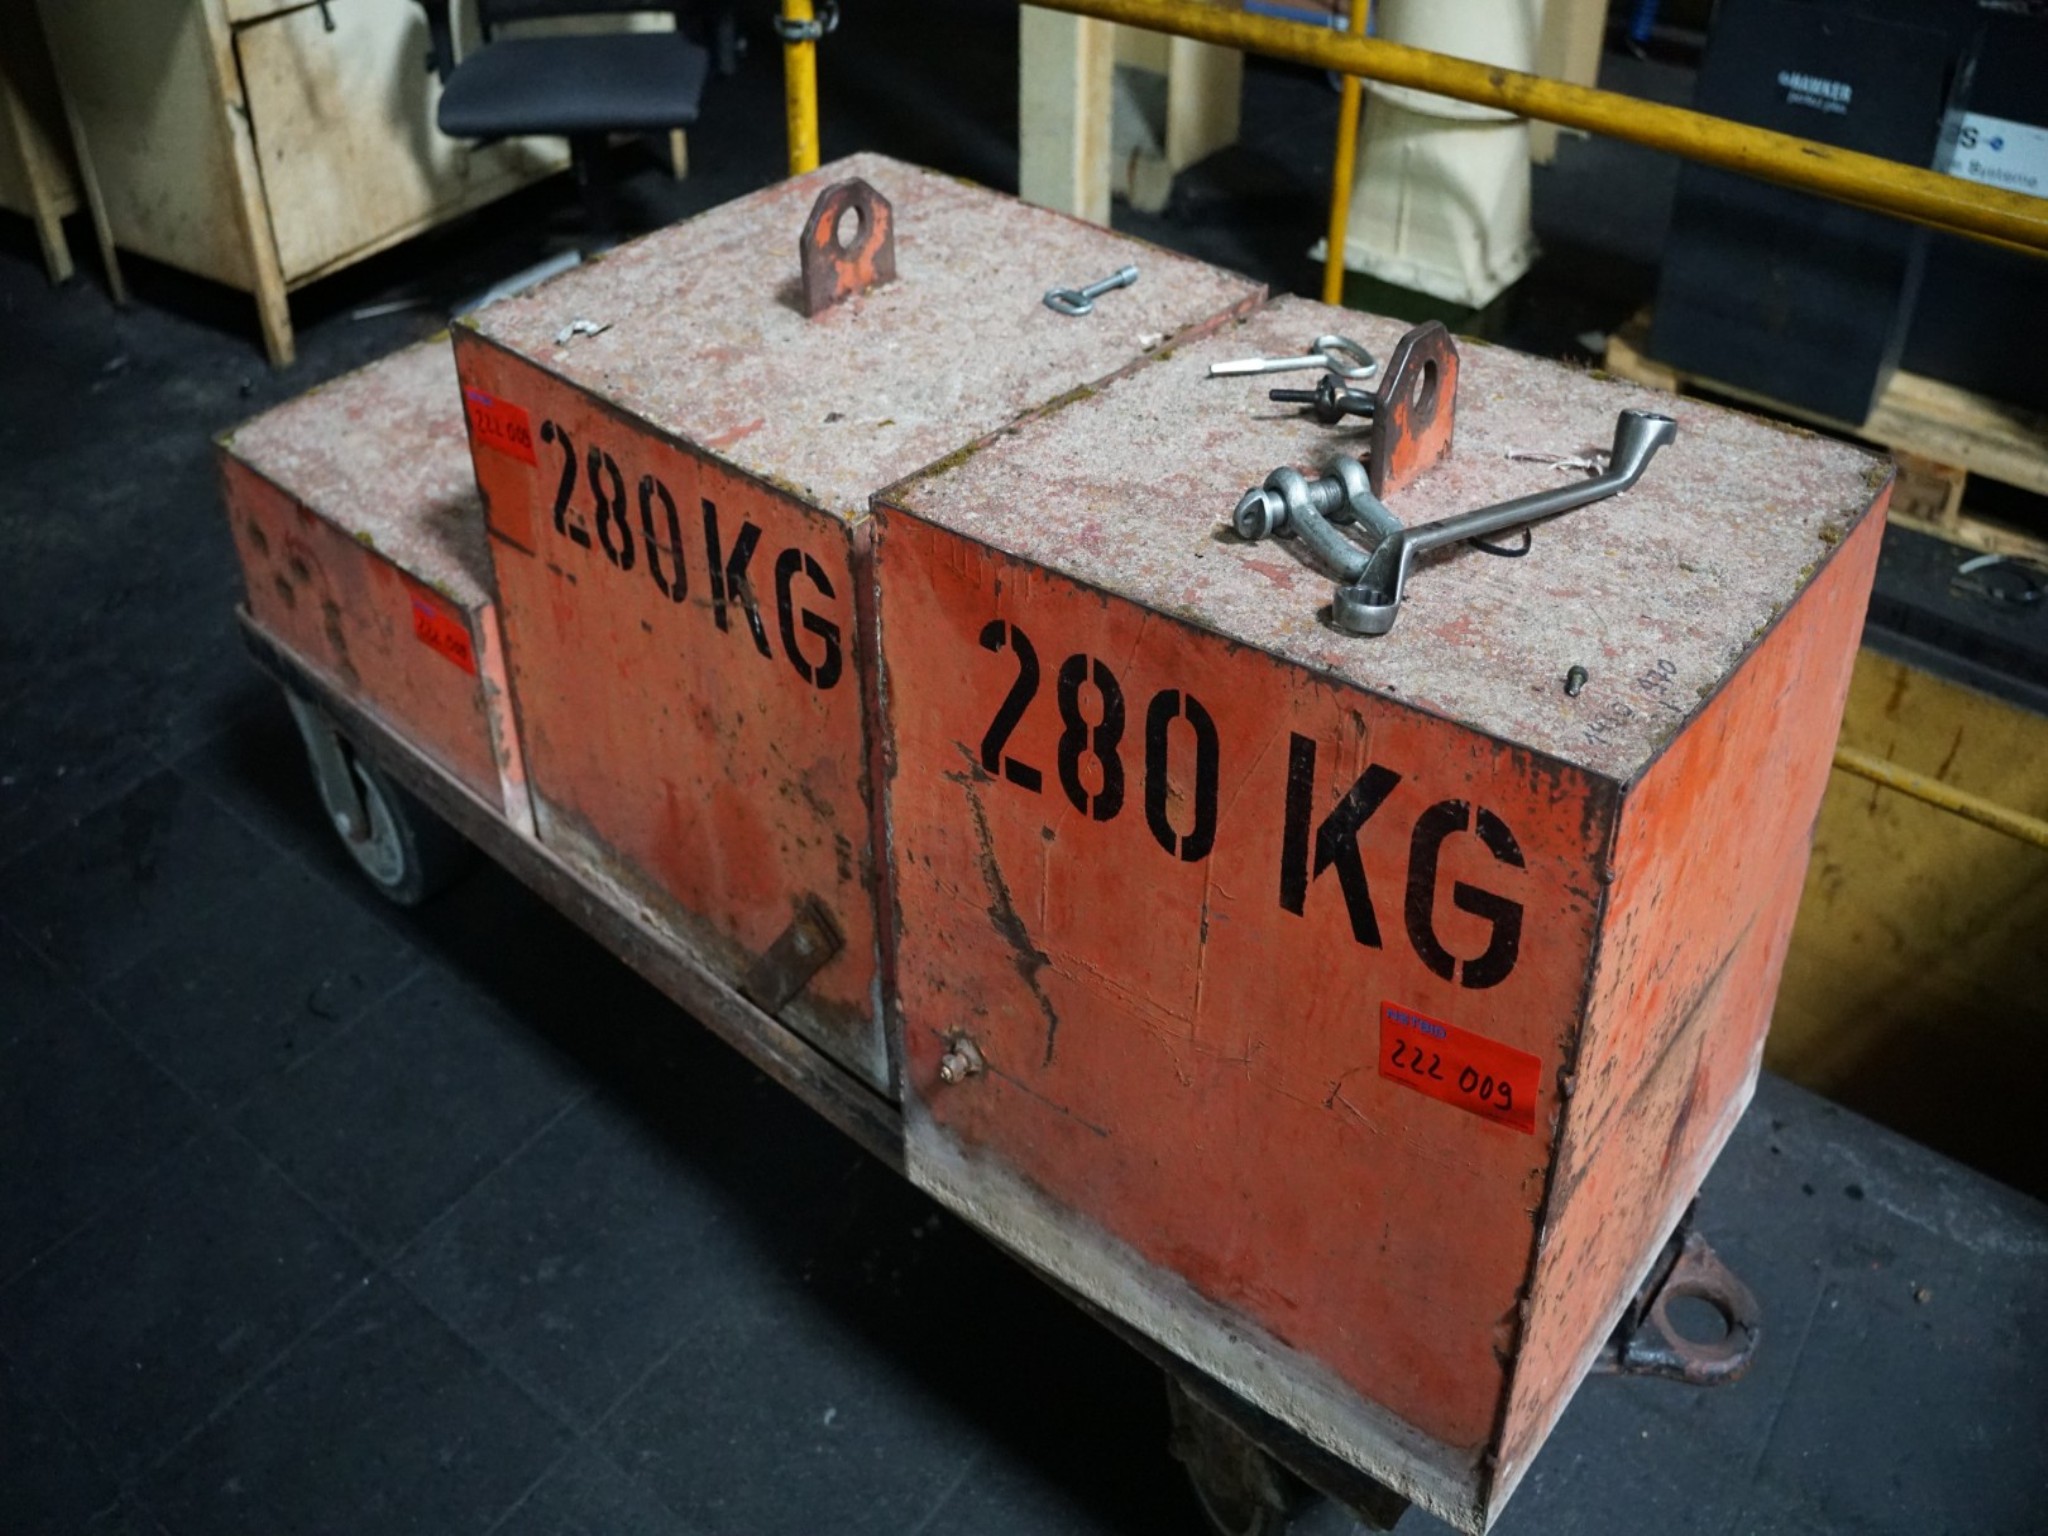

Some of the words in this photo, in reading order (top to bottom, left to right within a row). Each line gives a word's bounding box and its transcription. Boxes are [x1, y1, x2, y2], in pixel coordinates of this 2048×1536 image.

[540, 420, 688, 604] 280
[702, 497, 843, 690] KG
[979, 618, 1220, 863] 280
[1279, 731, 1526, 990] KG
[1391, 1038, 1444, 1081] 222
[1458, 1065, 1513, 1111] 009
